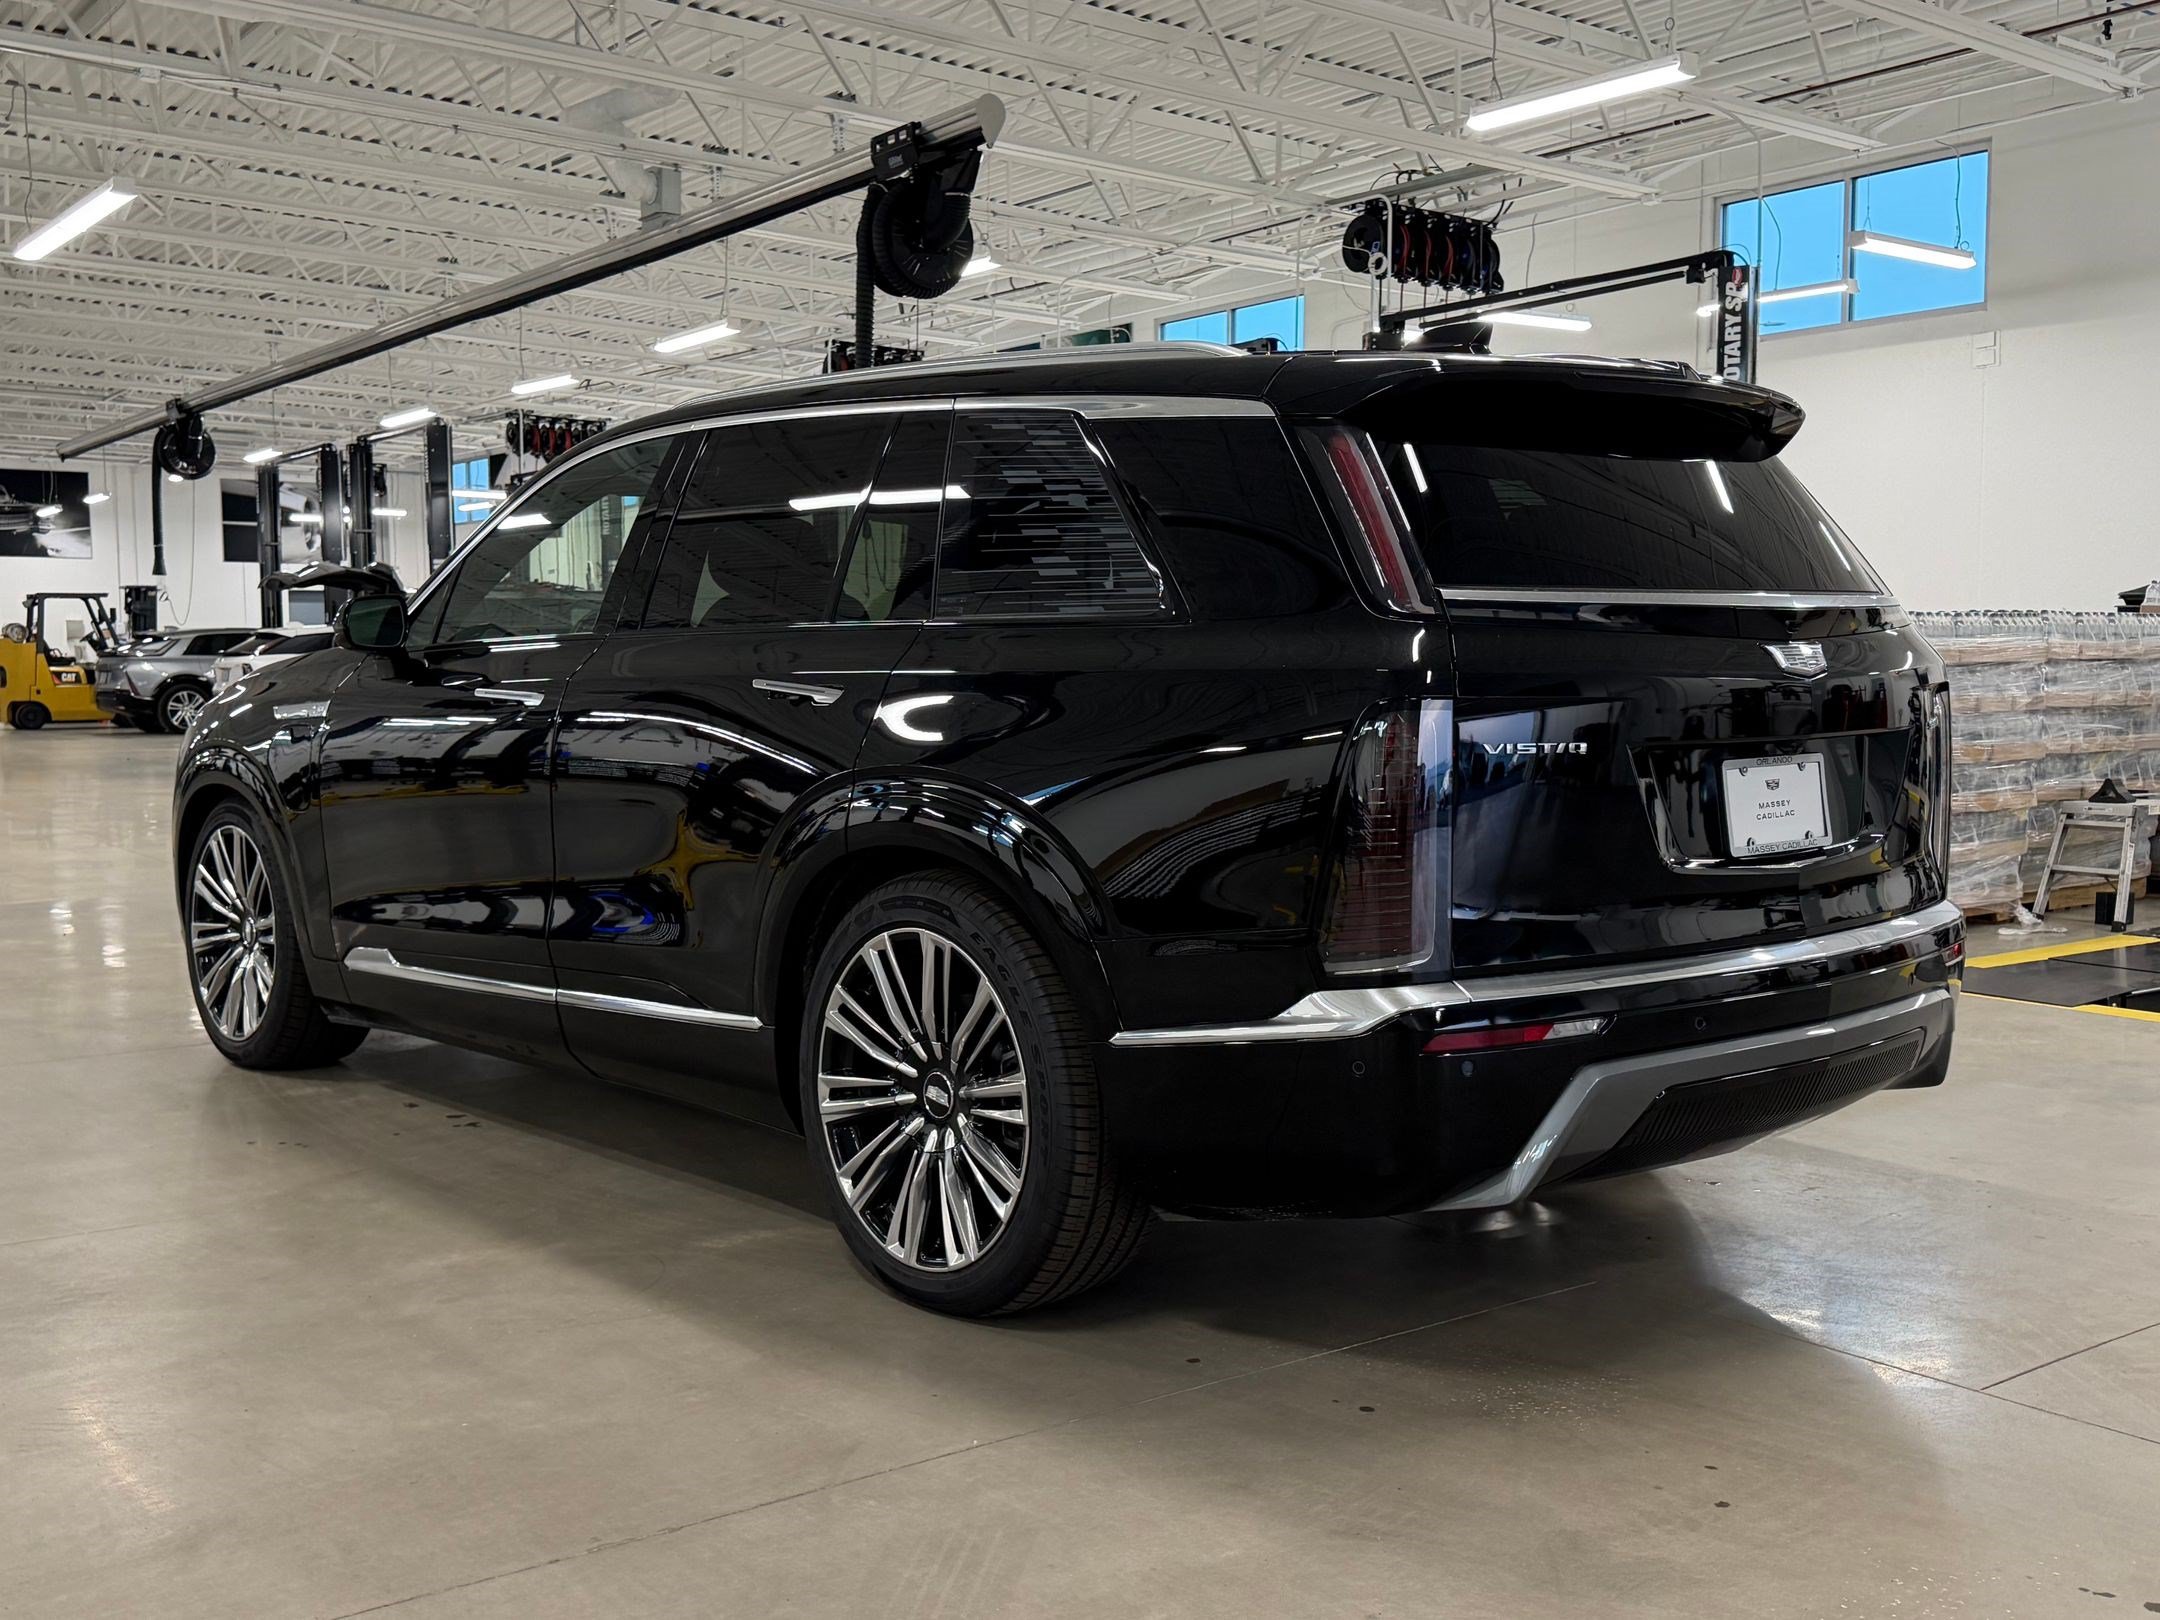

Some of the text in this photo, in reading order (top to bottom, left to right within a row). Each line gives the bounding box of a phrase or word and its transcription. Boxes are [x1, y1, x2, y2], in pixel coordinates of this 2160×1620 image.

[1723, 313, 1742, 380] OTARY
[61, 672, 77, 682] CAT
[1483, 742, 1588, 755] VISTIQ
[1756, 756, 1793, 766] ORLANDO
[1758, 799, 1791, 810] MASSEY
[1756, 809, 1796, 821] CADILLAC
[1747, 838, 1819, 854] MASSEY CADILLAC
[970, 932, 1033, 1029] EAGLE
